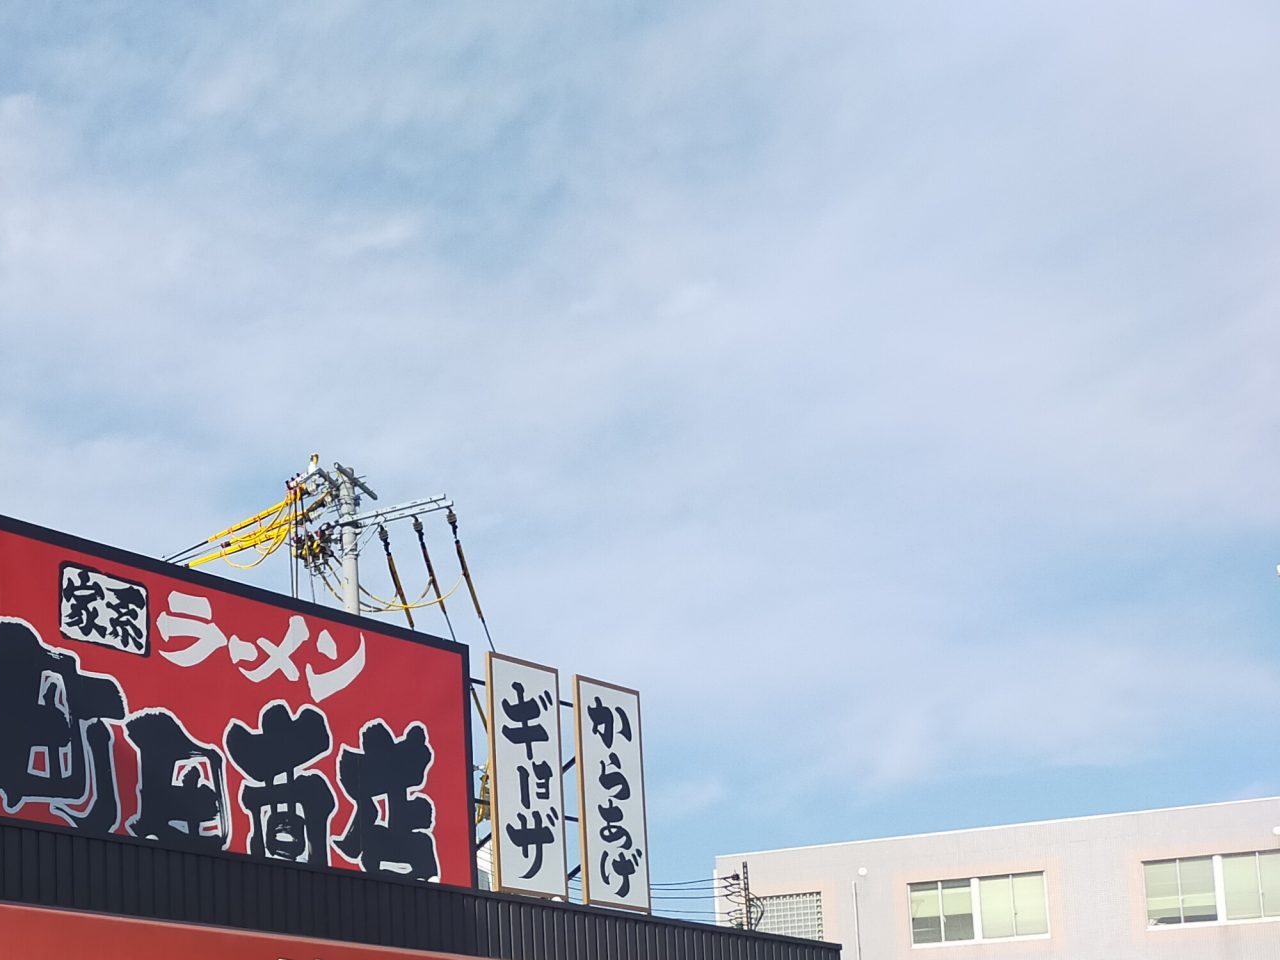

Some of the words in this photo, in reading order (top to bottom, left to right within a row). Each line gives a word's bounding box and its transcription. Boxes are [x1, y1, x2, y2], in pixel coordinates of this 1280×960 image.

[61, 568, 148, 653] 家系
[157, 591, 366, 702] ラーメン
[501, 681, 559, 879] ギョーザ
[586, 695, 642, 899] からあげ
